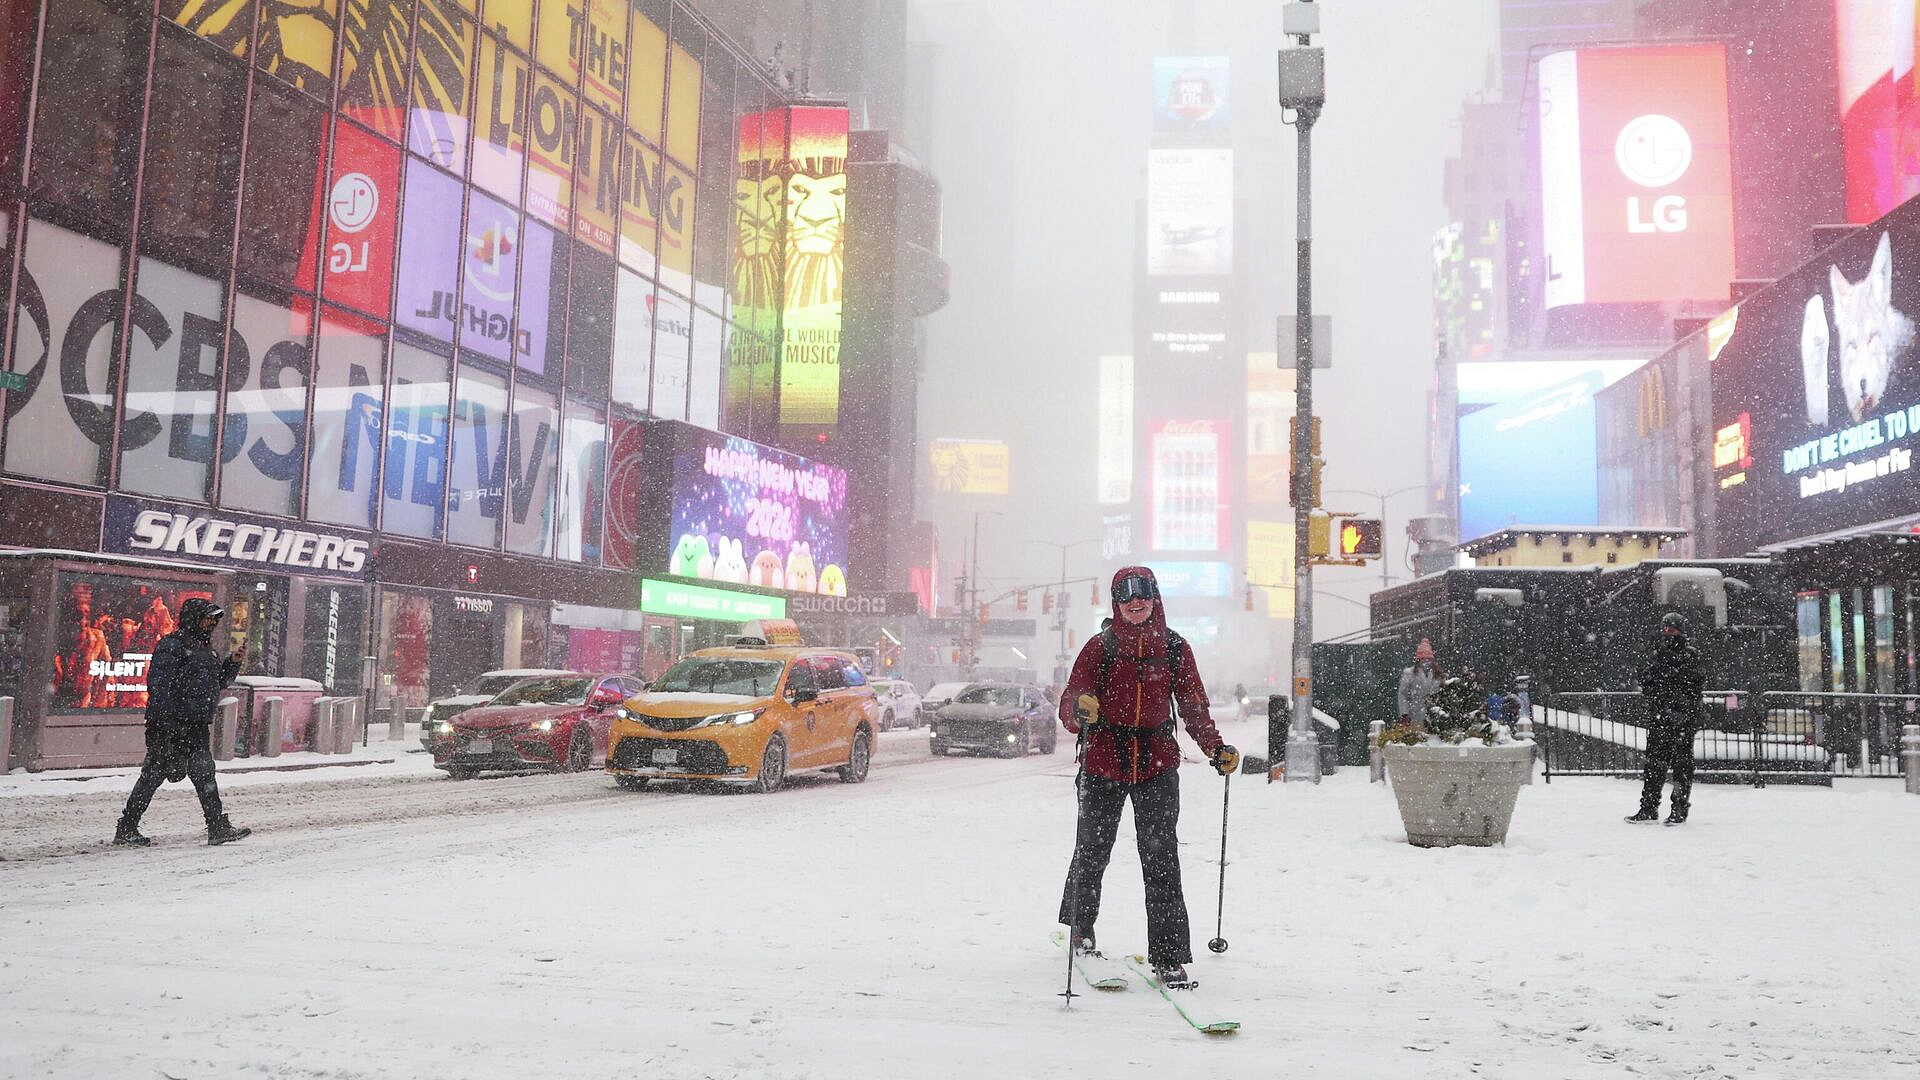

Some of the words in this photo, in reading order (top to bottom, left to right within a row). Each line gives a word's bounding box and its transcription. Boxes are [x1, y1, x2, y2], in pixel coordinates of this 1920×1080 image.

[566, 3, 625, 92] THE
[489, 21, 594, 178] LION
[596, 100, 683, 234] KING
[530, 192, 569, 223] ENTRANCE
[578, 219, 591, 235] ON
[594, 229, 612, 247] 45TH
[1627, 194, 1687, 233] LG
[1159, 291, 1220, 303] SAMSUNG
[798, 329, 840, 343] WORLD
[60, 289, 316, 481] CBS
[1783, 439, 1820, 474] DON'T
[1820, 433, 1839, 462] BE
[1839, 419, 1885, 456] CRUEL
[1884, 410, 1907, 442] TO
[704, 446, 759, 484] HAPPY
[759, 458, 794, 496] NEW
[795, 469, 830, 503] YEAR
[130, 510, 369, 573] SKECHERS
[745, 498, 792, 540] 2026
[792, 594, 870, 614] swatch
[325, 589, 339, 690] SKECHERS
[89, 660, 146, 681] SILENT
